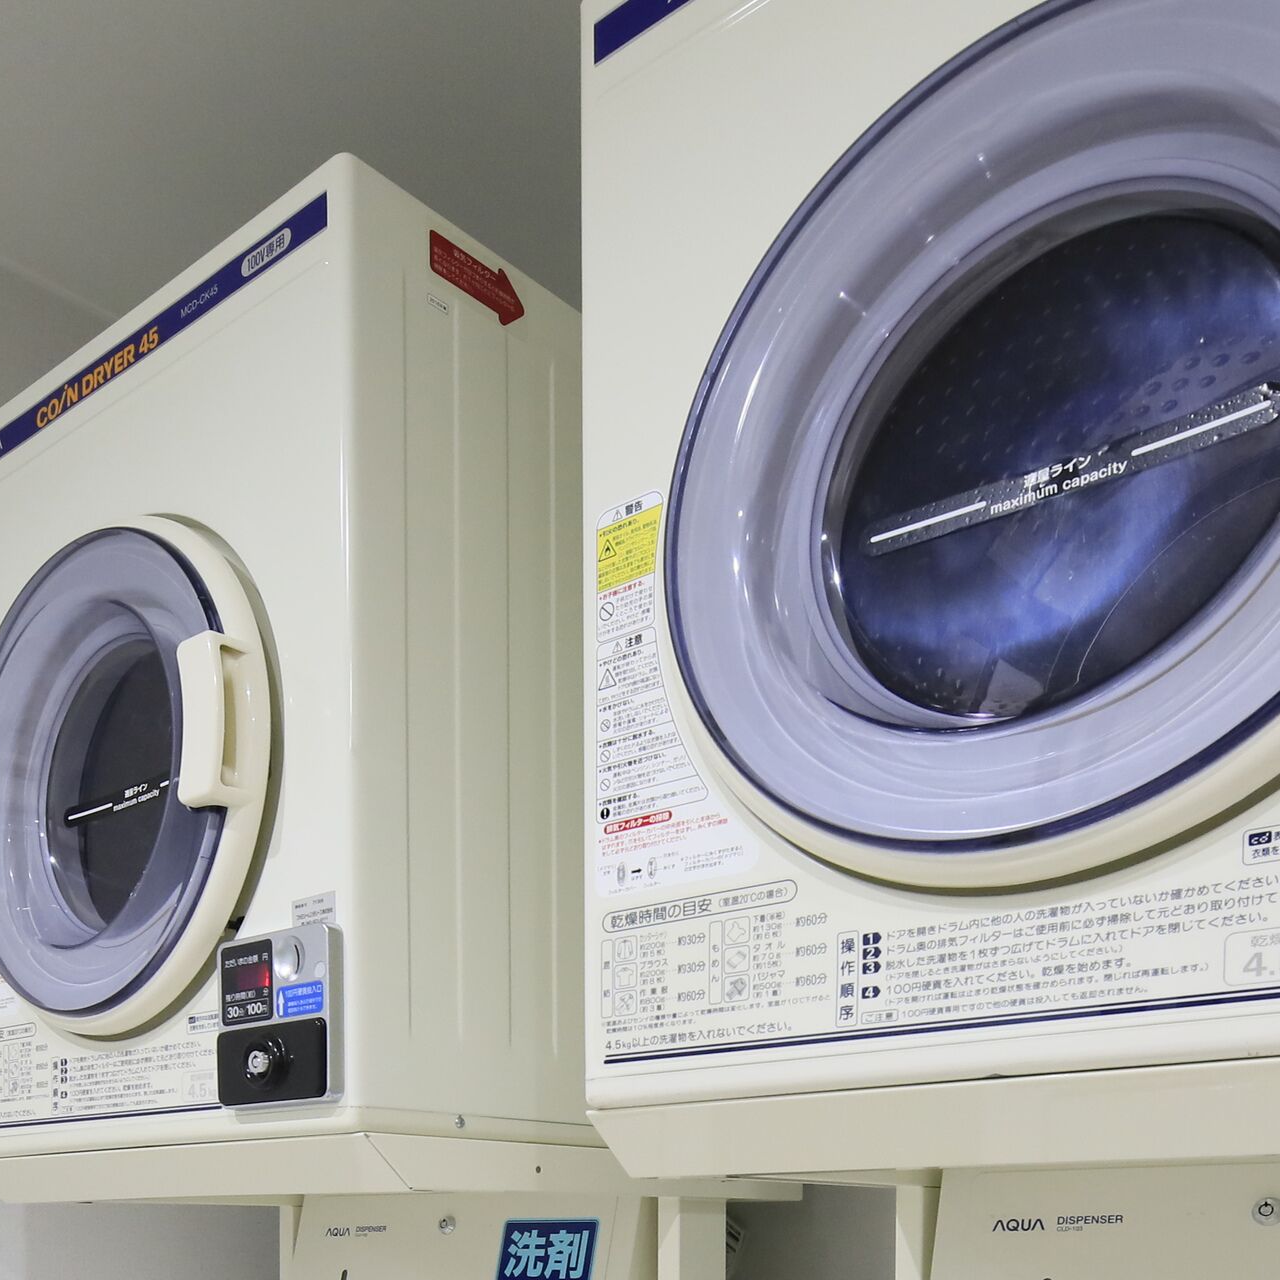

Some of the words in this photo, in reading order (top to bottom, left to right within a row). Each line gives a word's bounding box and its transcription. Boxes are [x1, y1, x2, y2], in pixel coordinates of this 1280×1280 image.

[81, 343, 136, 397] DRYER
[138, 326, 160, 354] 45
[990, 483, 1058, 515] maximum
[1062, 460, 1128, 490] capacity
[625, 501, 643, 516] 警告
[625, 634, 643, 649] 注意
[610, 898, 713, 929] 乾燥時間の目安
[838, 938, 856, 1021] 操作順序
[605, 1022, 793, 1050] 4.5kg以上の洗濯物を入れないでください。
[325, 1227, 351, 1237] AQUA
[992, 1218, 1045, 1232] AQUA
[1057, 1214, 1124, 1225] DISPENSER
[503, 1229, 590, 1280] 洗剤
